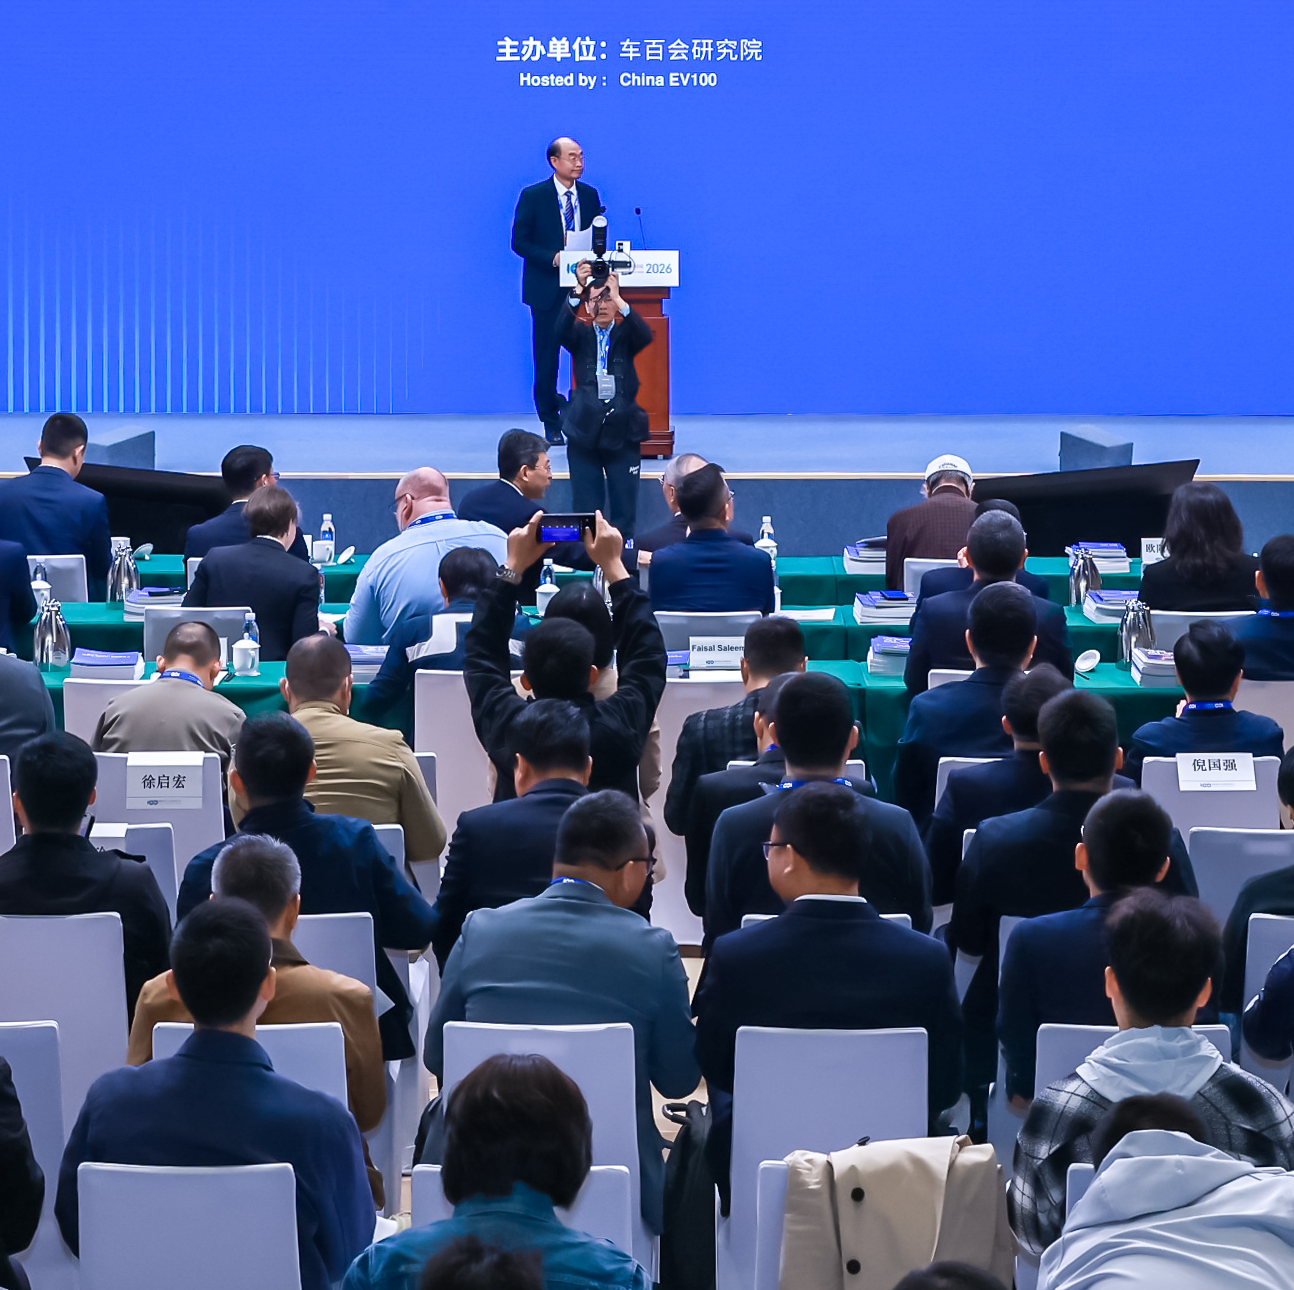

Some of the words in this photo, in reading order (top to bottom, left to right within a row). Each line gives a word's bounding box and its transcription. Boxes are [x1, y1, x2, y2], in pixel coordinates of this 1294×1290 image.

[619, 38, 763, 61] 车百会研究院
[519, 72, 574, 87] Hosted
[619, 72, 665, 87] China
[669, 72, 718, 87] EV100
[646, 263, 673, 274] 2026
[691, 644, 716, 652] Faisal
[1192, 758, 1238, 772] 倪国强
[141, 774, 187, 790] 徐启宏
